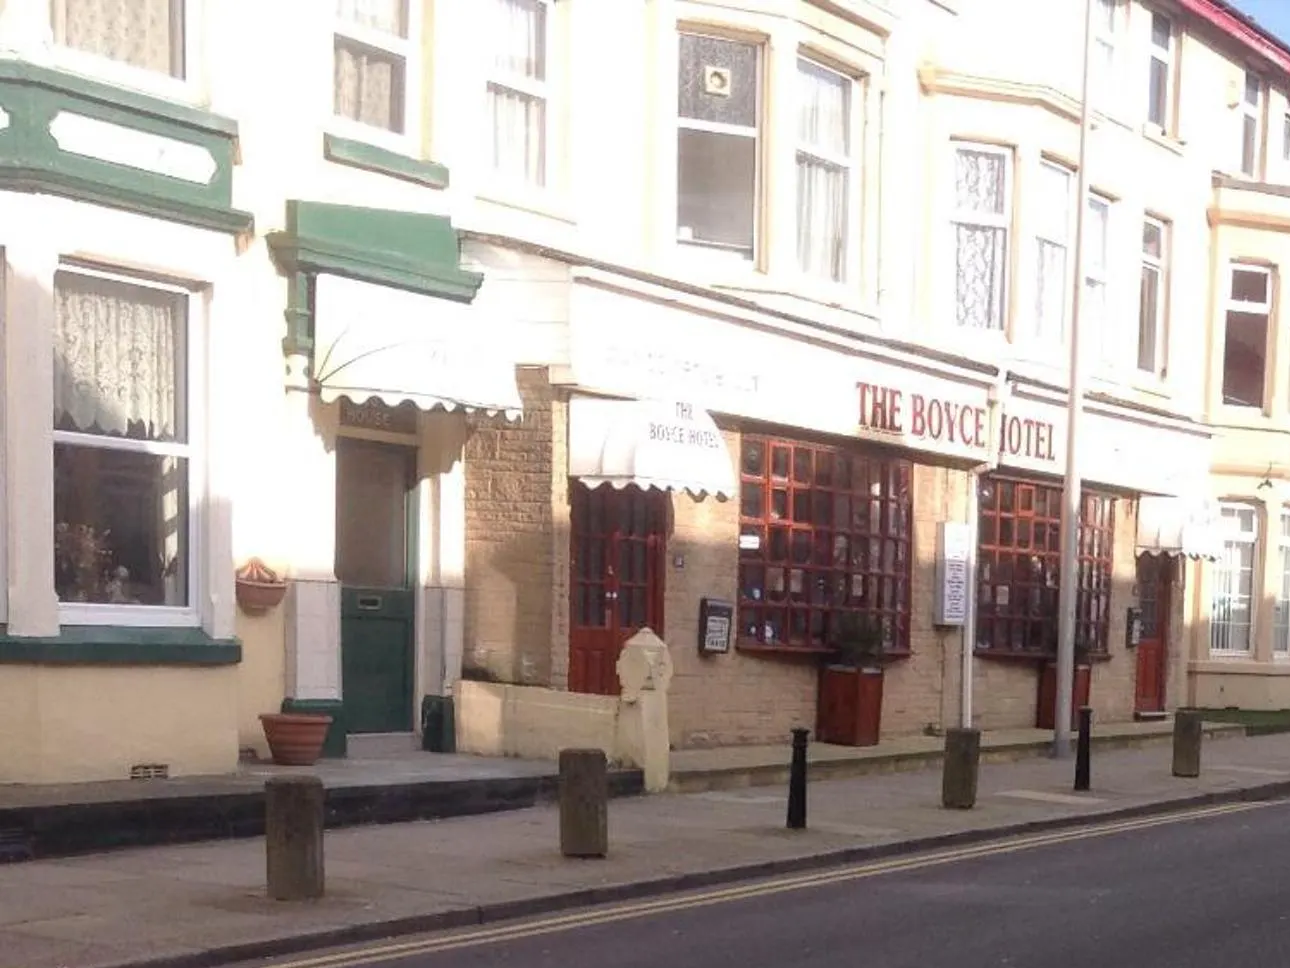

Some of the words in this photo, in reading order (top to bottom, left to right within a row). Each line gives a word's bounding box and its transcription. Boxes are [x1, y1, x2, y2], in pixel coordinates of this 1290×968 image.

[675, 401, 694, 421] THE
[855, 381, 903, 432] THE
[910, 393, 986, 448] BOYCE
[648, 422, 685, 444] BOYCE
